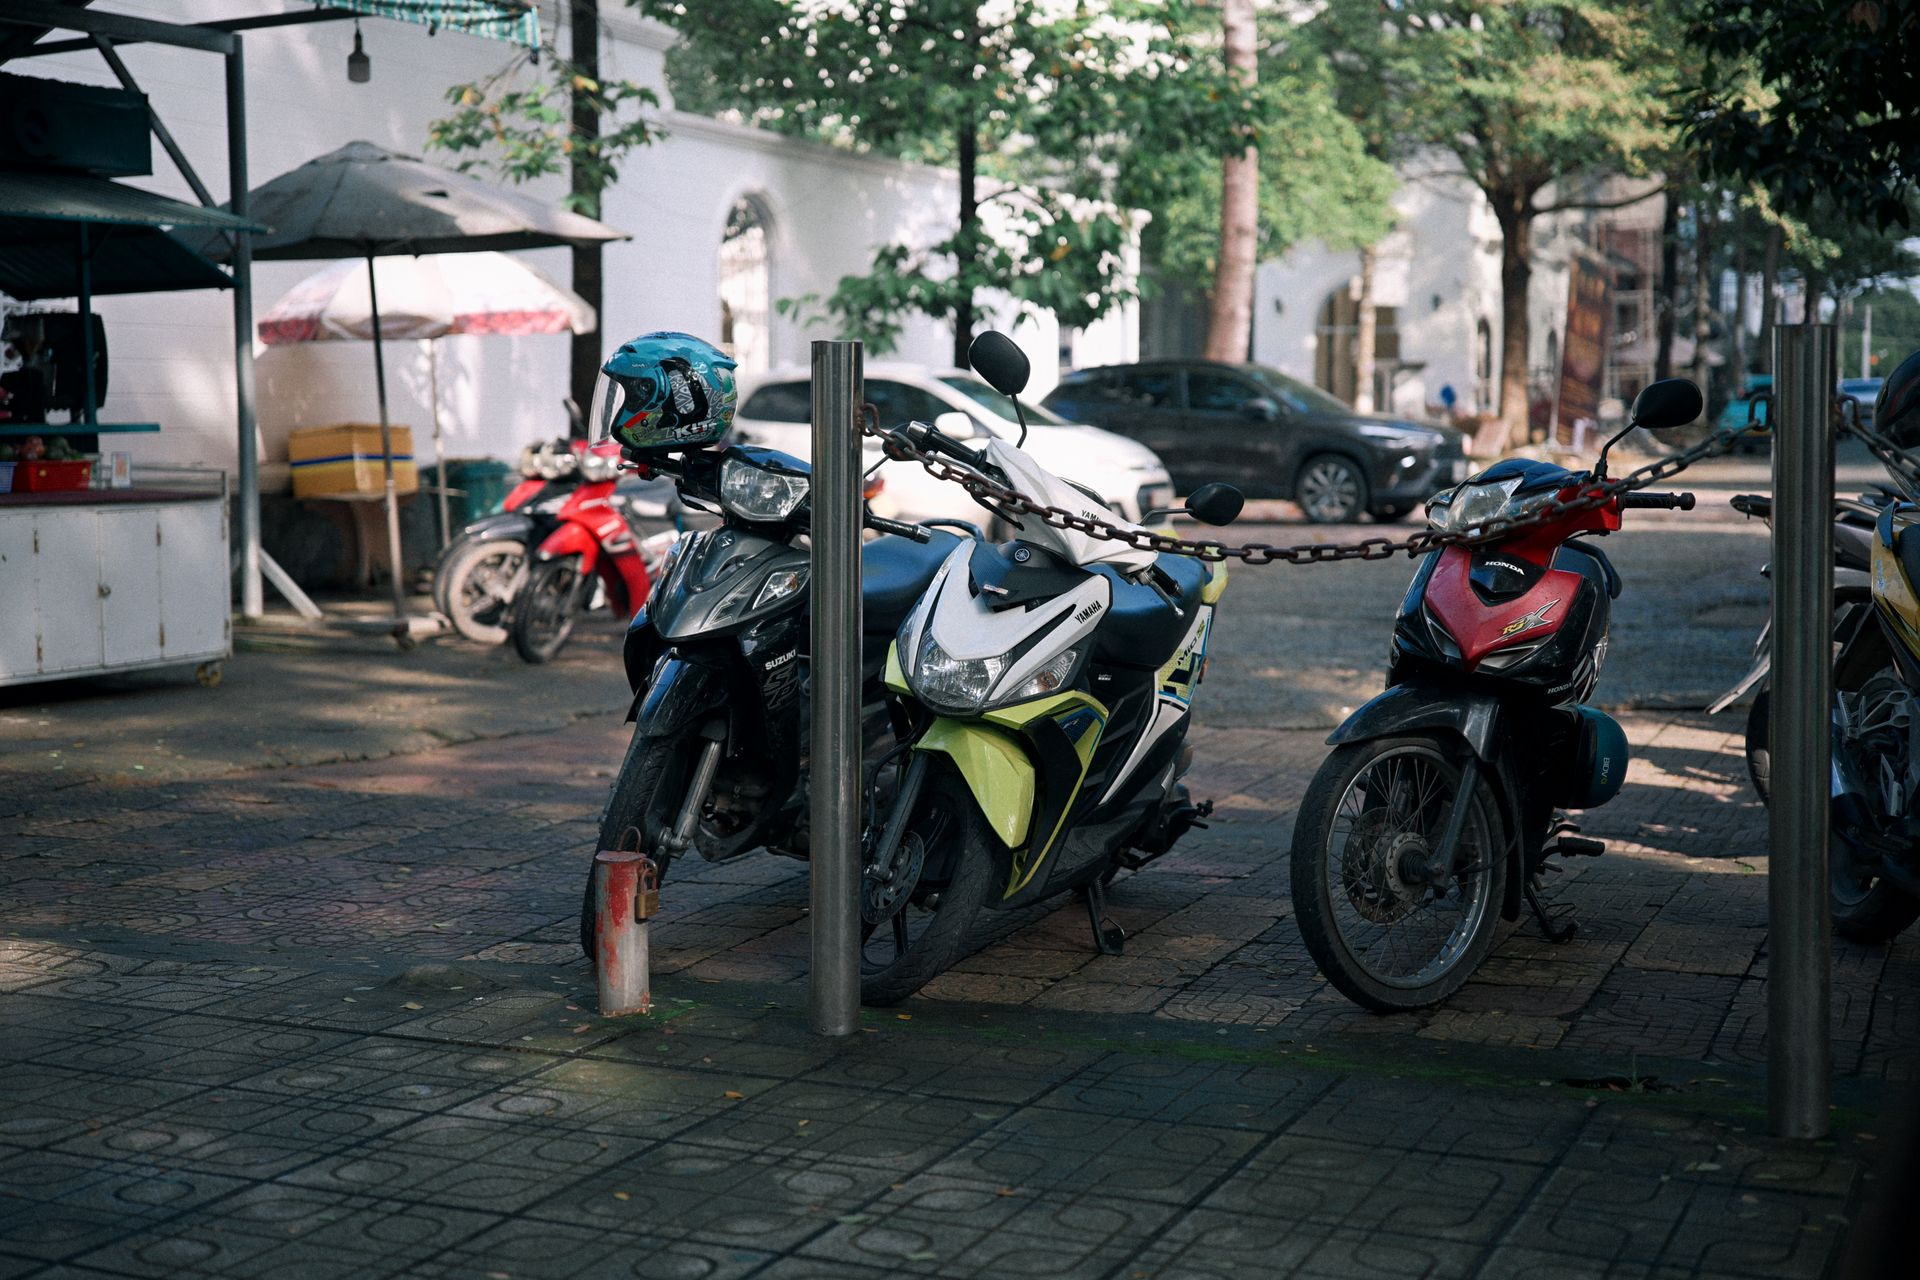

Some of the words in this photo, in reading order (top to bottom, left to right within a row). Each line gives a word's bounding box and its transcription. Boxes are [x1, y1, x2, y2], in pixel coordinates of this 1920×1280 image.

[1484, 561, 1525, 576] HONDA
[1074, 600, 1103, 624] YAMAHA
[765, 648, 797, 671] SUZUKI
